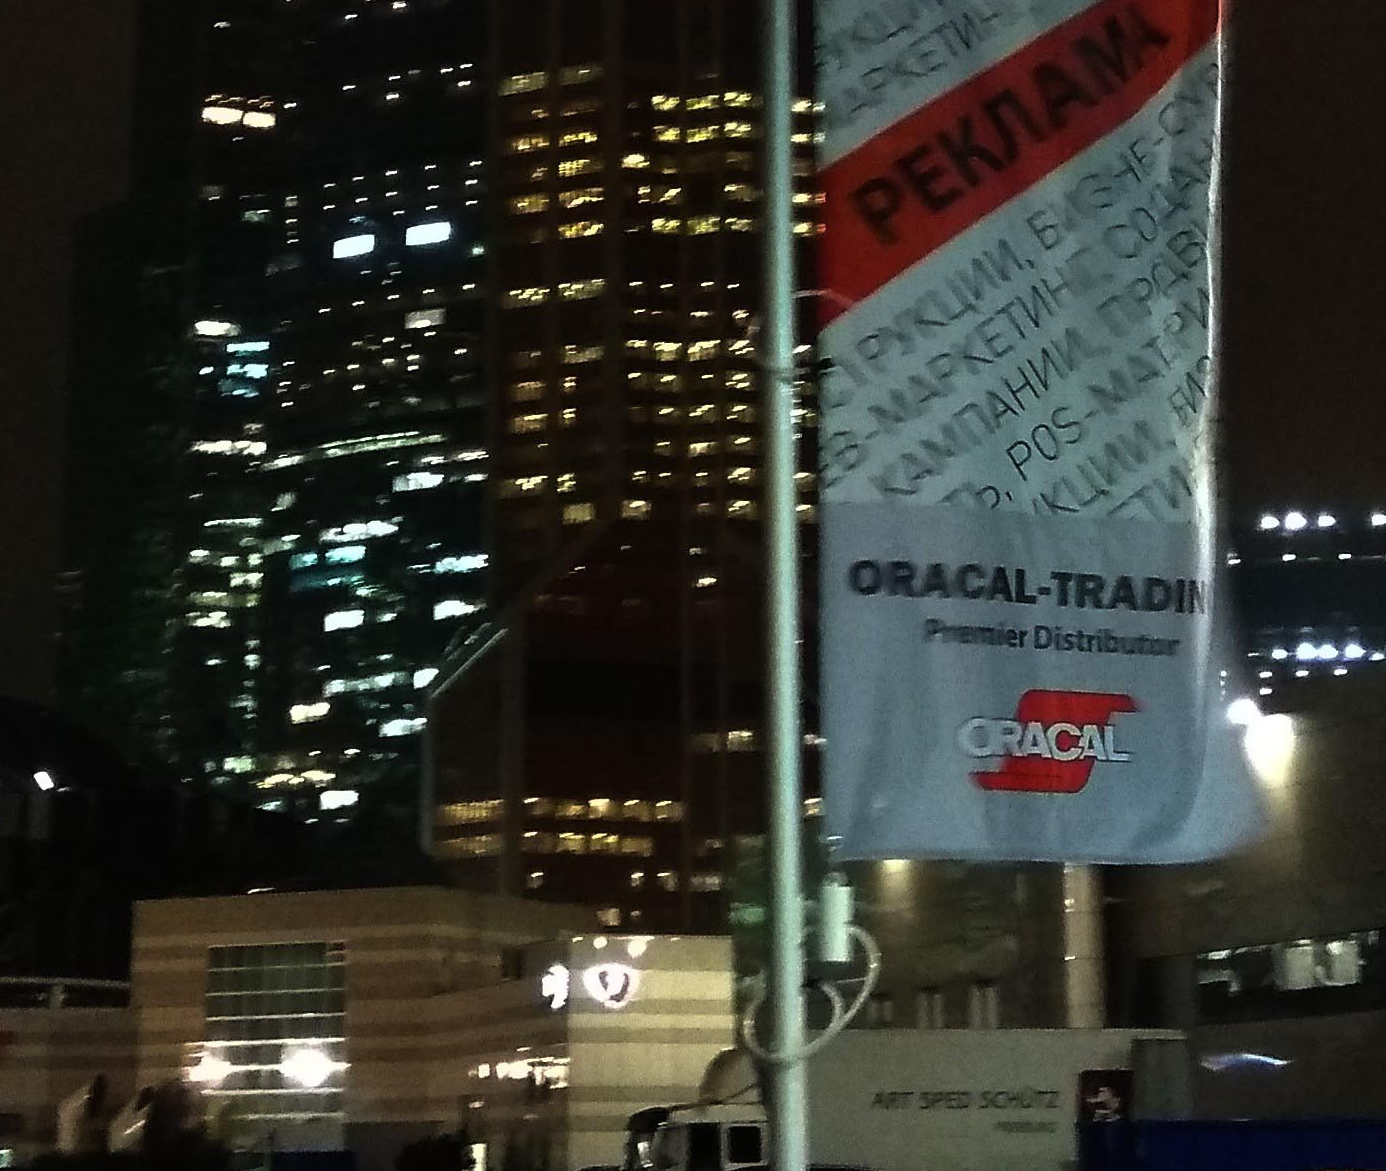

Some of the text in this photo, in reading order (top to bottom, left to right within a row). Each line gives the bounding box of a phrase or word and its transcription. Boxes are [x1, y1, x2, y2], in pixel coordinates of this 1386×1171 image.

[851, 7, 1170, 246] РЕКЛАМА
[848, 559, 1204, 615] ORACAL-TRADIN
[922, 617, 1182, 656] Premier Distributor
[956, 717, 1136, 763] ORACAL
[869, 1090, 914, 1111] ART
[917, 1089, 970, 1111] SPED
